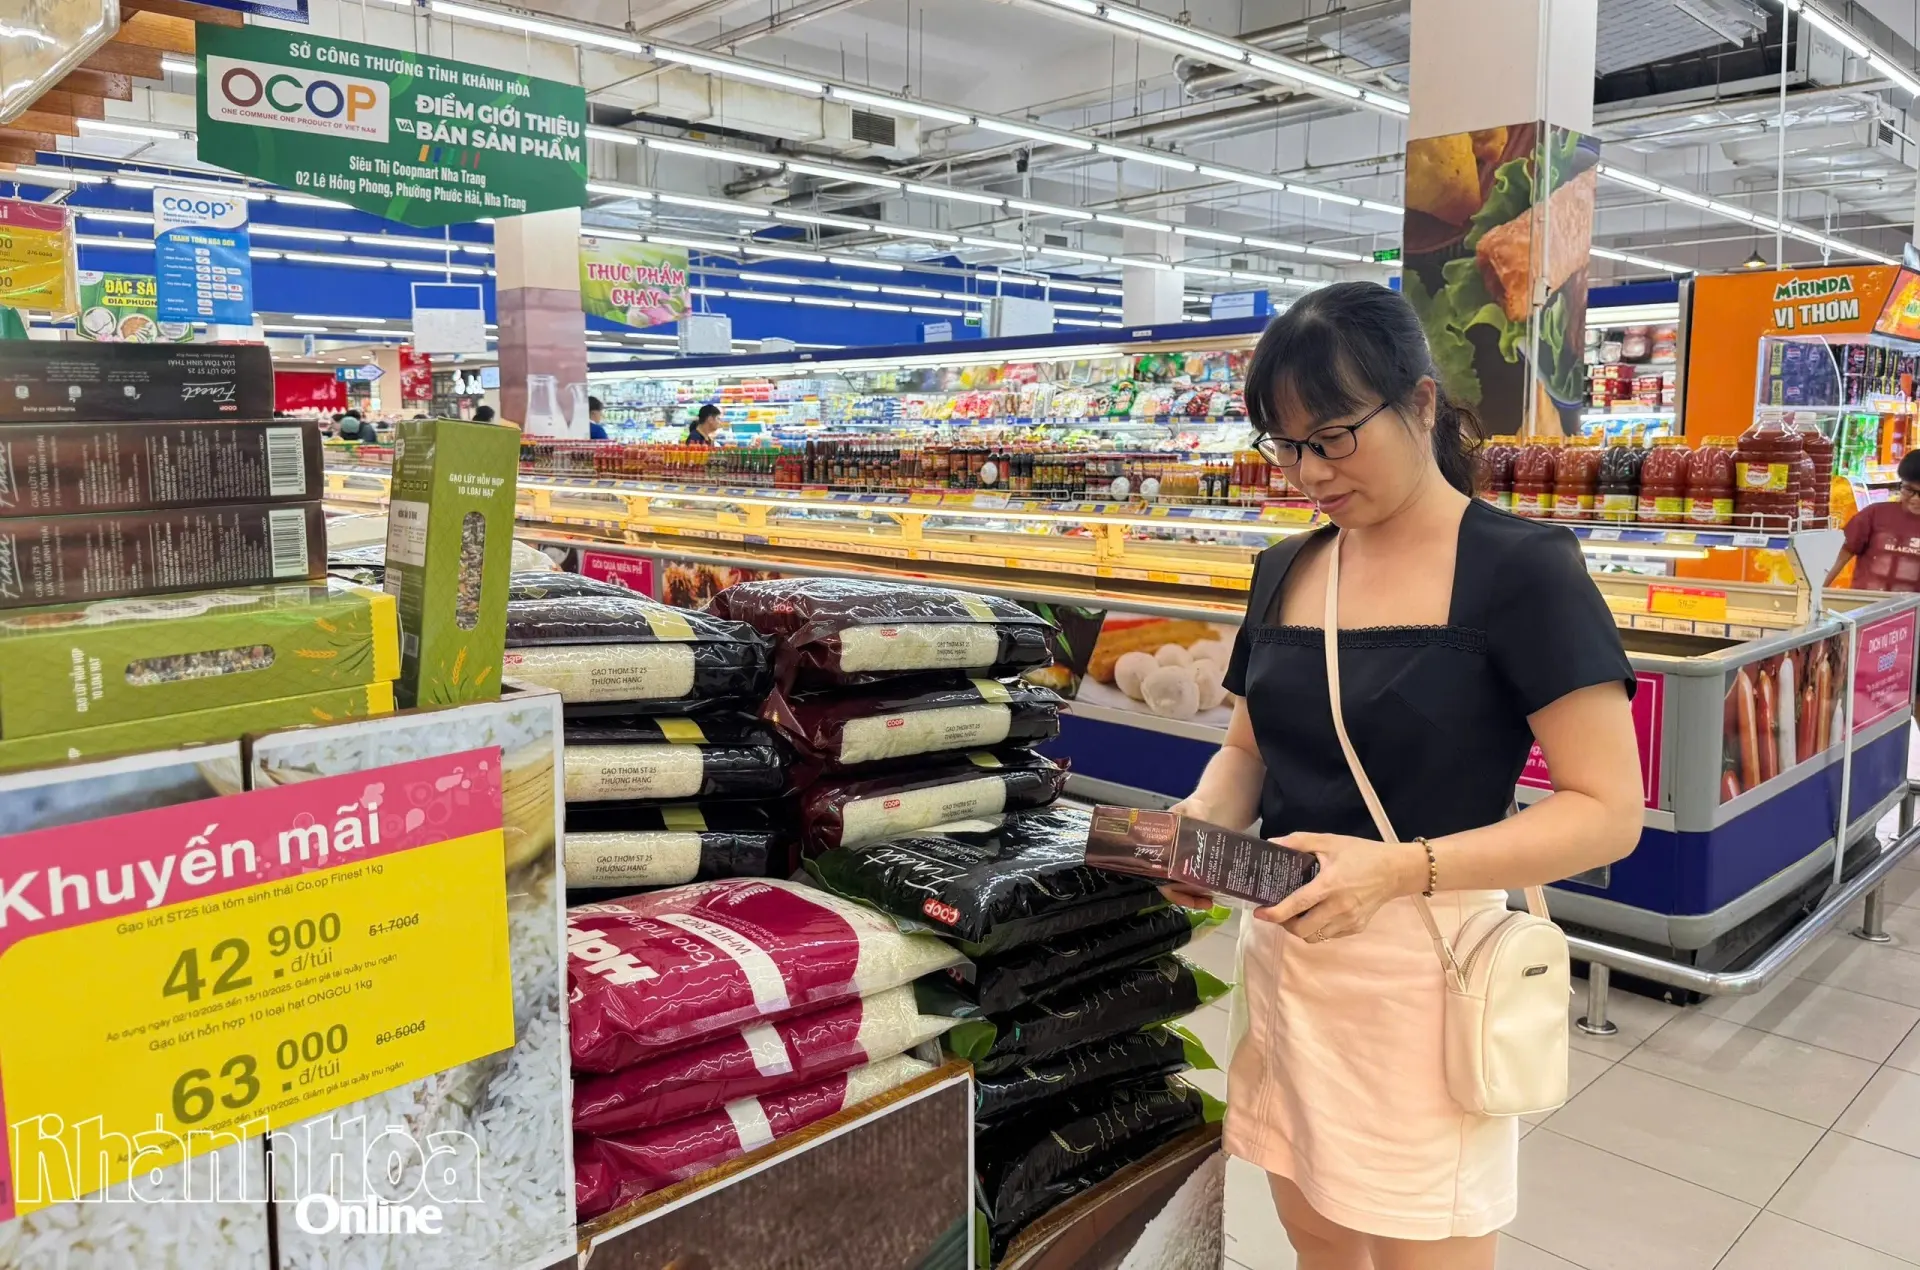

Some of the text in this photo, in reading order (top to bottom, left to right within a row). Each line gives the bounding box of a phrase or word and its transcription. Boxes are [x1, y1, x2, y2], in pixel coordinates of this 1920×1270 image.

[289, 41, 530, 98] SỞ CÔNG THƯƠNG TỈNH KHÁNH HÒA
[221, 68, 376, 122] OCOP
[221, 107, 238, 116] ONE
[240, 109, 278, 120] COMMUNE
[280, 115, 296, 124] ONE
[297, 117, 332, 128] PRODUCT
[345, 123, 360, 132] VIET
[361, 126, 376, 134] NAM
[415, 92, 580, 139] ĐIỂM GIỚI THIỆU
[416, 120, 467, 146] BÁN
[471, 126, 516, 153] SẢN
[520, 135, 580, 163] PHẨM
[349, 155, 486, 188] Siêu Thị Coopmart Nha Trang
[296, 171, 527, 212] 02 Lê Hồng Phong, Phường Phước Hải, Nha Trang
[104, 279, 133, 298] ĐẶC
[587, 262, 686, 286] THỰC PHẨM
[611, 289, 661, 307] CHAY
[1774, 298, 1859, 330] VỊ THƠM
[884, 800, 900, 808] COOP
[0, 801, 381, 927] Khuyến mãi
[116, 865, 383, 935] Gạo lứt ST25 lúa tôm sinh thái Co.op Finest 1kg
[924, 902, 959, 922] COOP
[617, 915, 672, 940] Trắng
[705, 928, 752, 955] WHITE
[291, 947, 333, 974] đ/túi
[672, 937, 715, 966] Gạo
[122, 1025, 146, 1037] dụng
[148, 1018, 171, 1032] ngày
[173, 1002, 223, 1024] 02/10/2025
[225, 996, 242, 1009] đến
[295, 977, 317, 989] Giảm
[318, 973, 331, 985] giá
[333, 968, 342, 980] tại
[344, 962, 363, 977] quầy
[364, 959, 377, 970] thu
[378, 952, 397, 967] ngân
[150, 978, 373, 1053] Gạo lứt hỗn hợp 10 loại hạt ONGCU 1kg
[299, 1058, 341, 1086] đ/túi
[234, 1112, 250, 1124] đến
[302, 1090, 325, 1101] Giảm
[326, 1084, 338, 1096] giá
[340, 1080, 350, 1092] tại
[351, 1074, 370, 1089] quầy
[371, 1070, 384, 1082] thu
[385, 1062, 404, 1075] ngân
